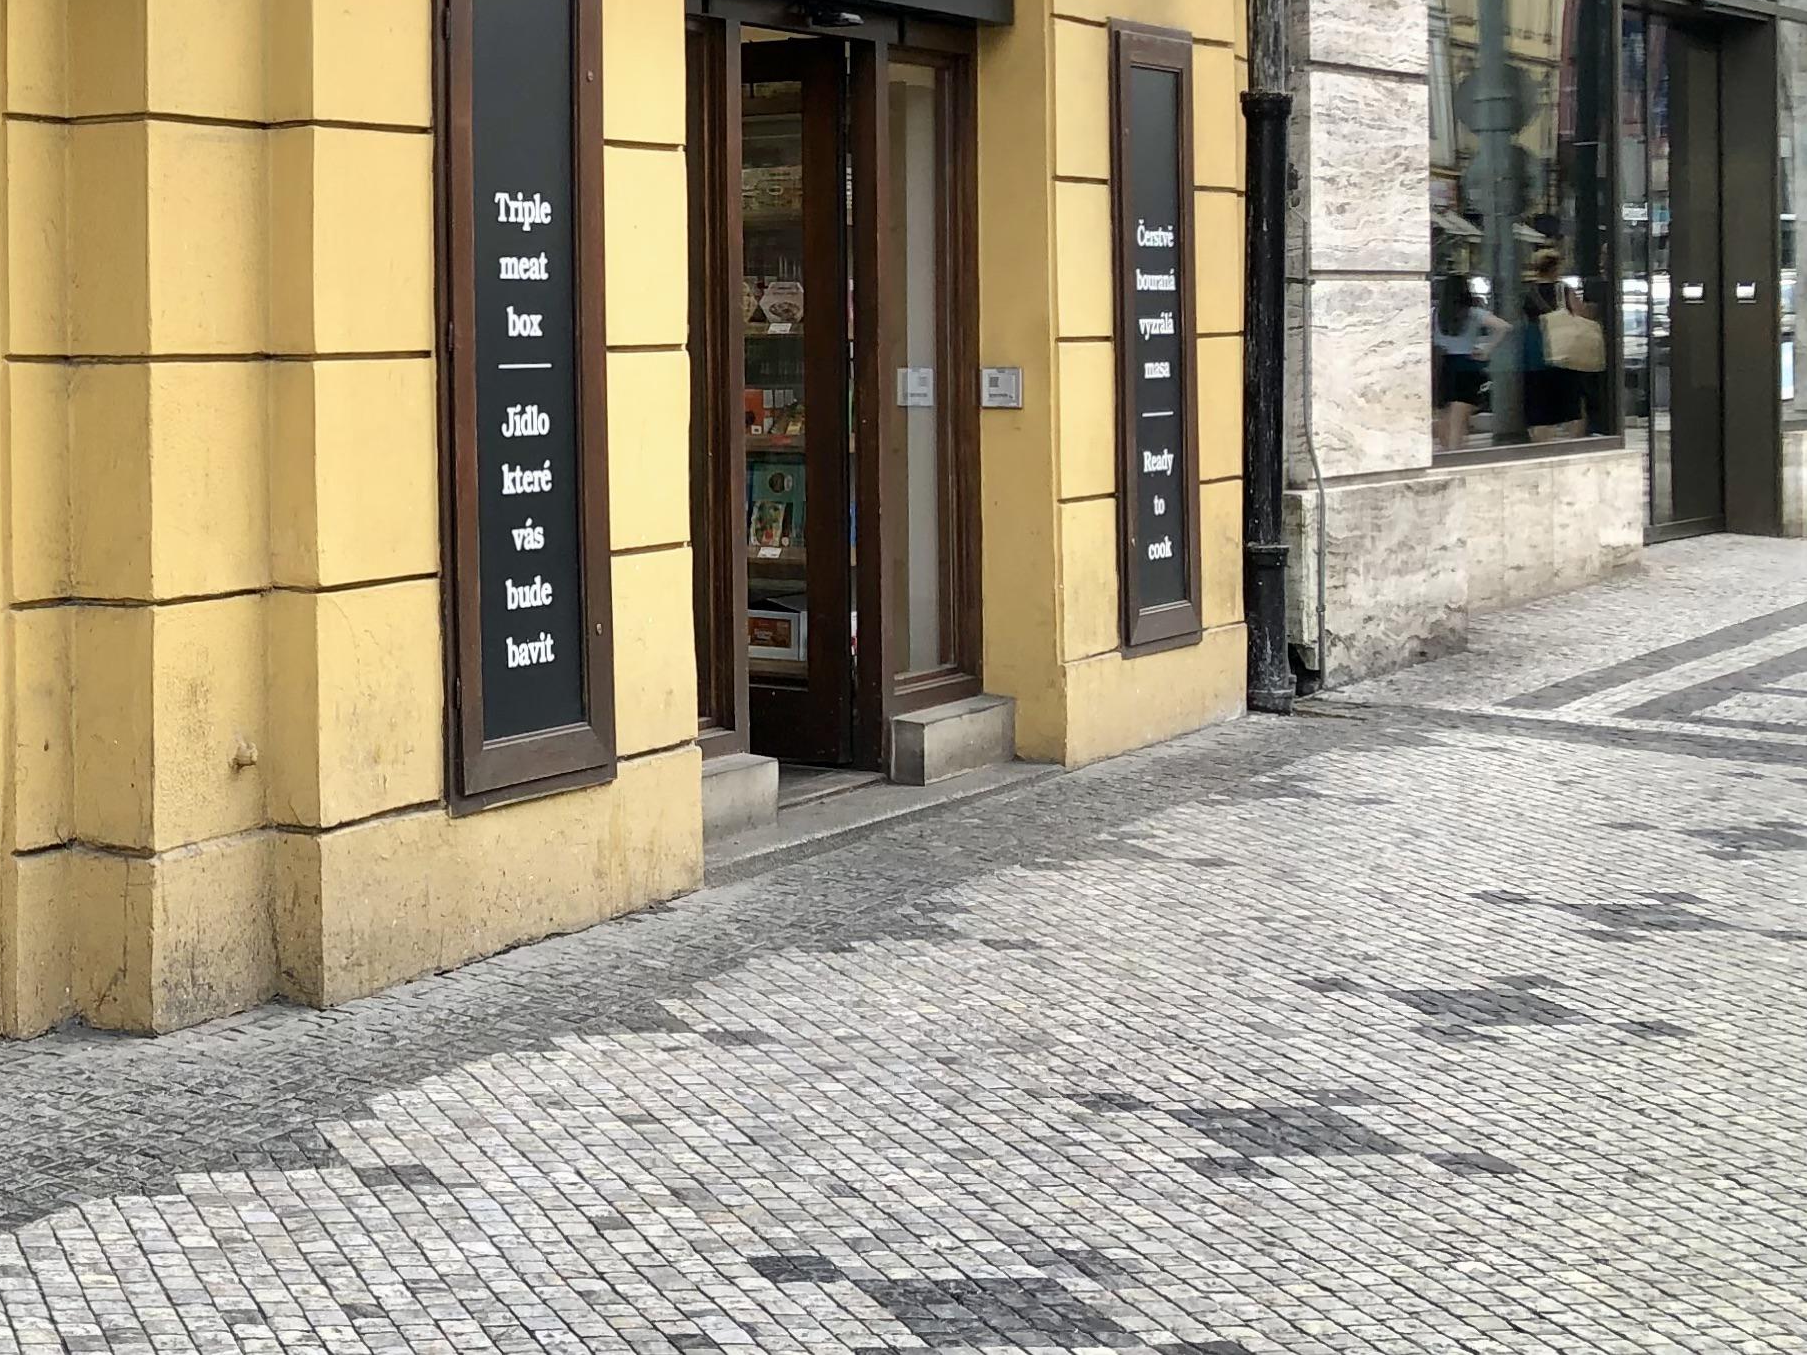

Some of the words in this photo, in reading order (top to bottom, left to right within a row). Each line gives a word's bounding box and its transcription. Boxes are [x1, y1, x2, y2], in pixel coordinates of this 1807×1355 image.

[494, 192, 553, 232] Triple
[498, 251, 550, 281] meat
[506, 305, 544, 337] box
[1138, 311, 1176, 341] vyzrálá
[1144, 361, 1172, 379] masa
[501, 404, 551, 438] Jídlo
[501, 459, 553, 495] které
[1142, 448, 1175, 476] Ready
[1153, 494, 1166, 516] to
[511, 517, 545, 552] vás
[1147, 535, 1173, 561] cook
[505, 575, 553, 611] bude
[506, 631, 556, 669] bavit
